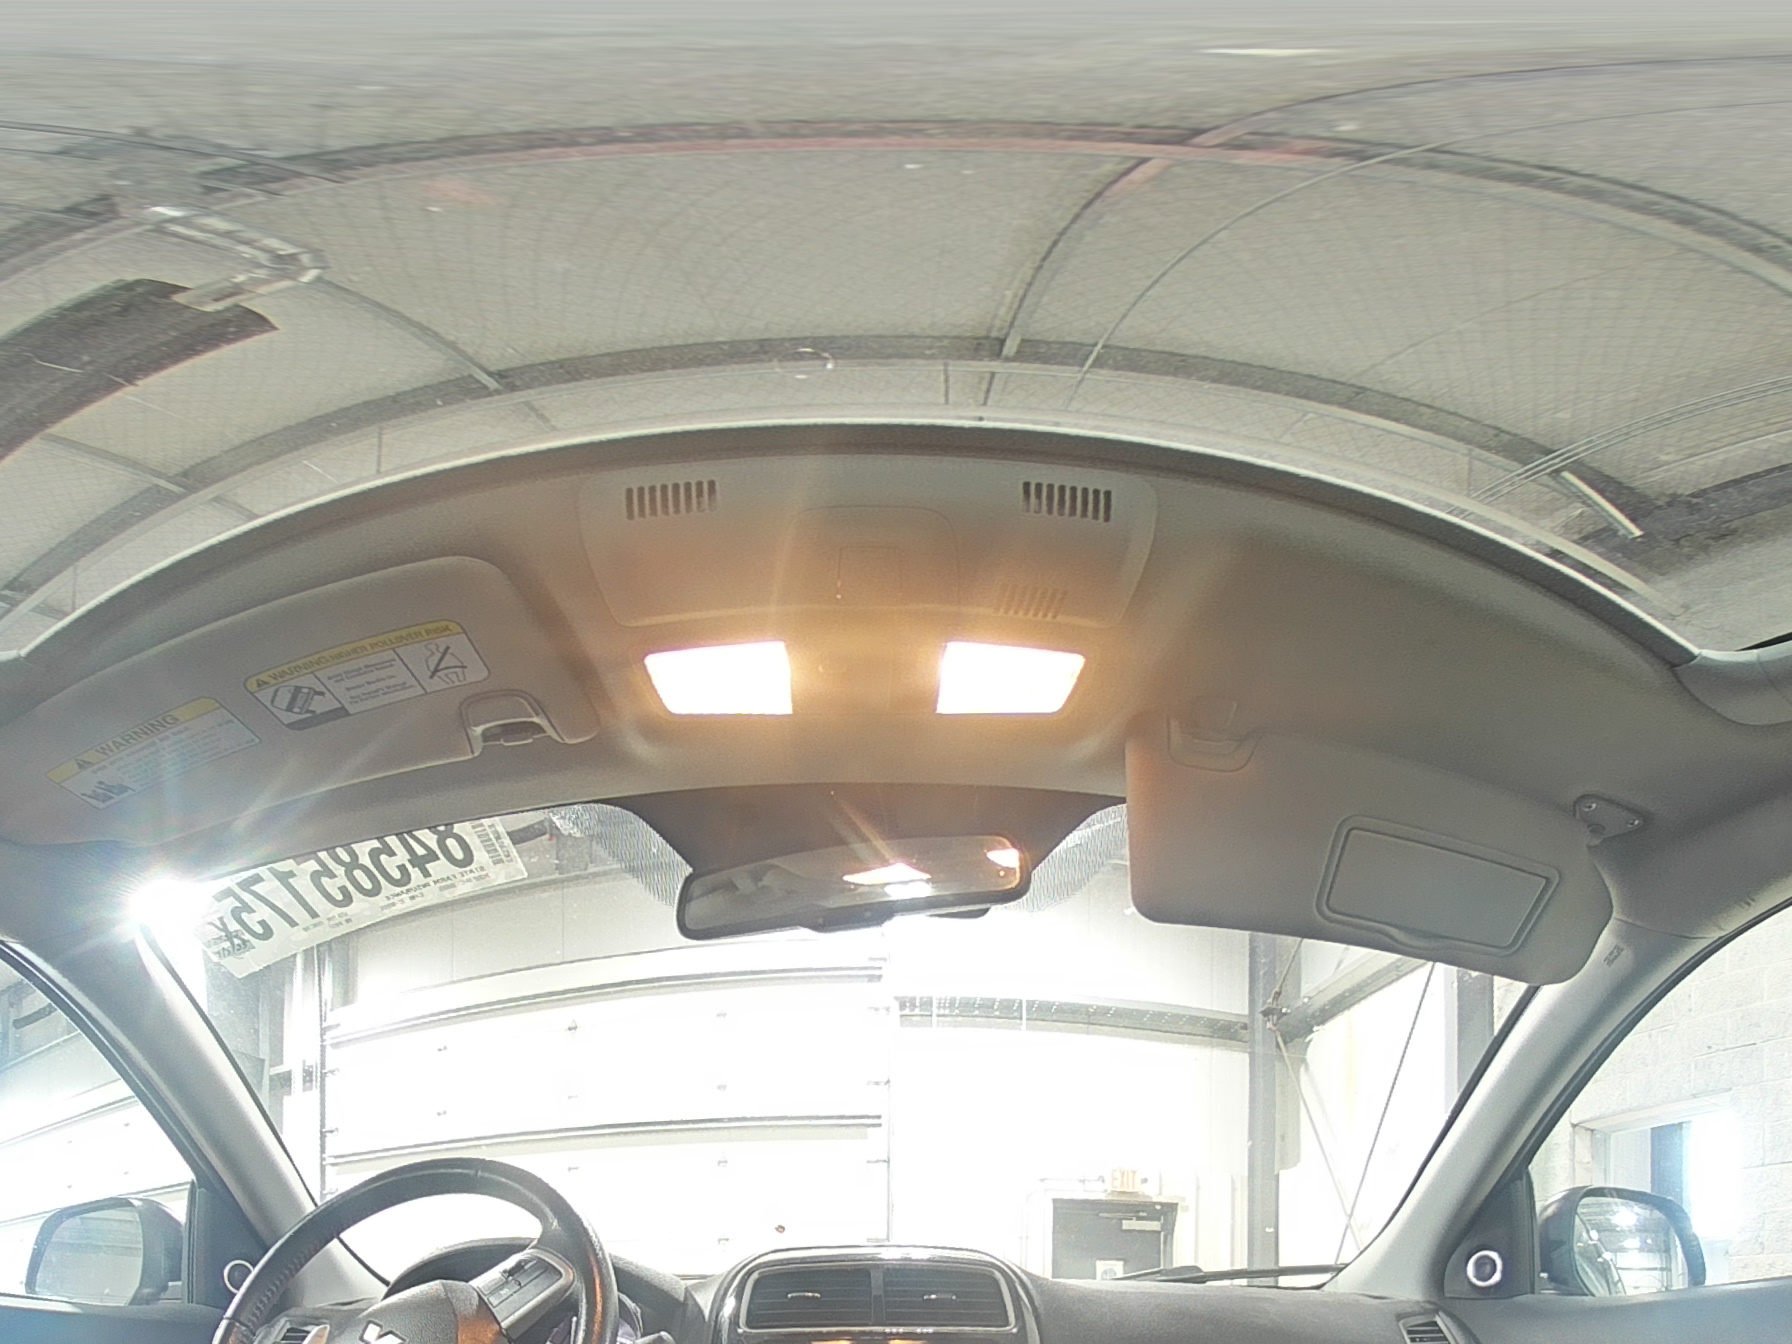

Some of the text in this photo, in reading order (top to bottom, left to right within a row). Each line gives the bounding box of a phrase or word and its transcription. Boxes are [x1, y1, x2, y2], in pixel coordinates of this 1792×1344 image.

[369, 631, 425, 651] ROLLOVER
[425, 624, 452, 637] RISK
[95, 713, 181, 757] WARNING
[1111, 1169, 1138, 1190] EXIT
